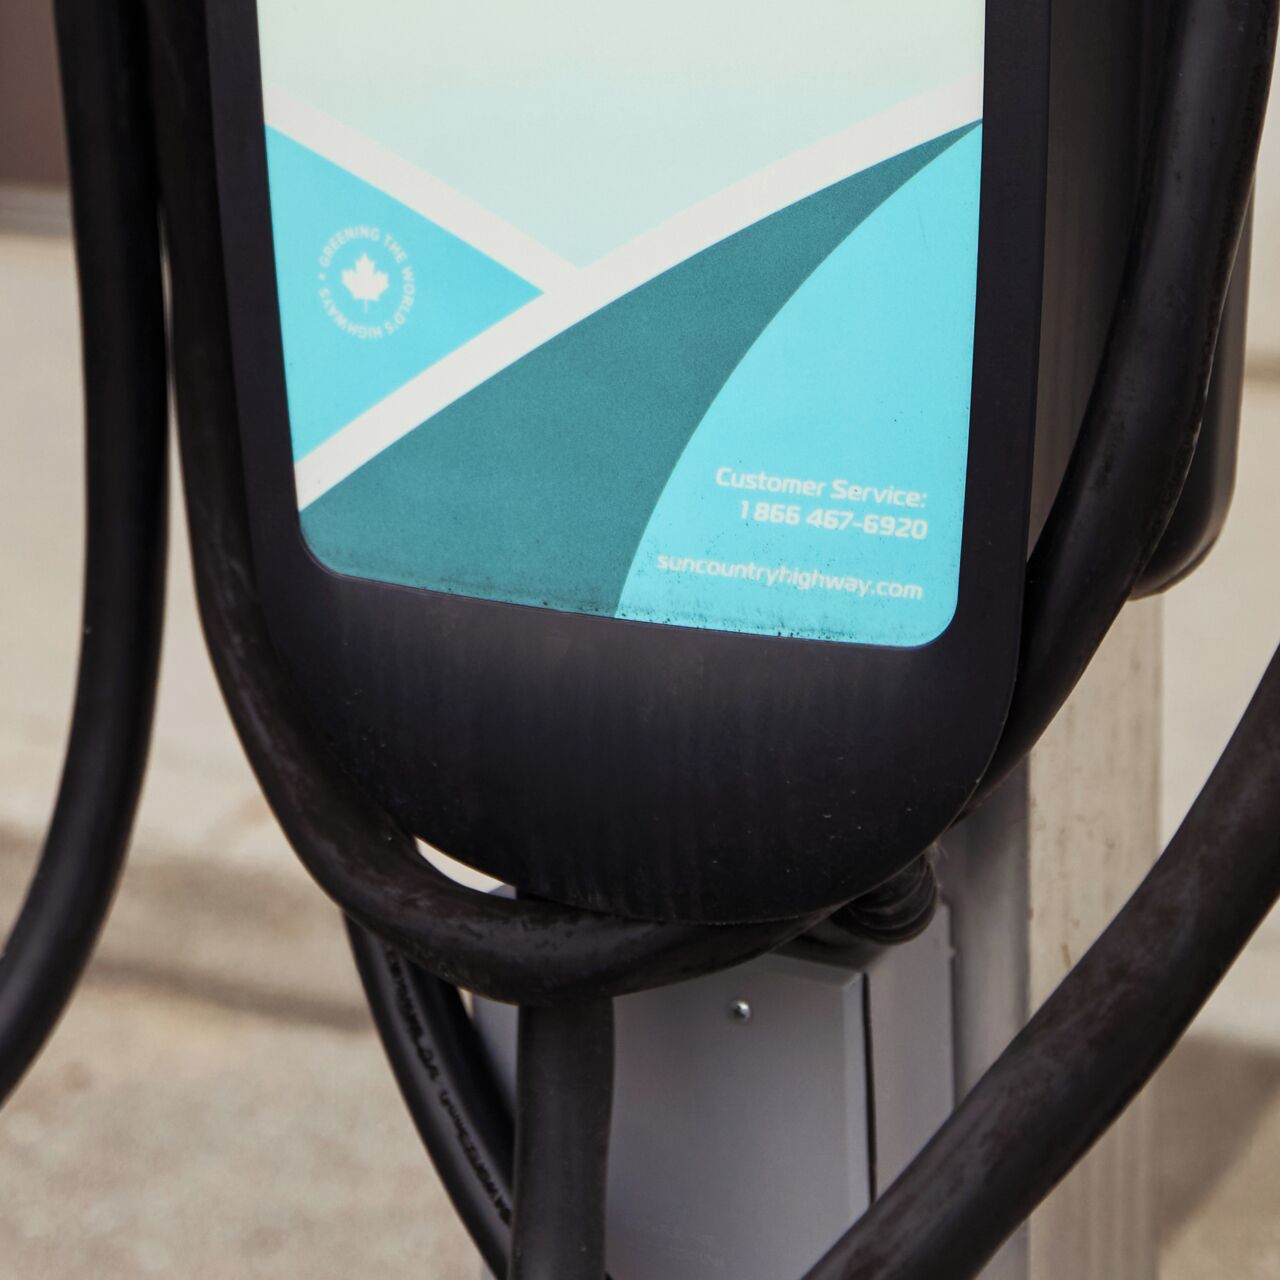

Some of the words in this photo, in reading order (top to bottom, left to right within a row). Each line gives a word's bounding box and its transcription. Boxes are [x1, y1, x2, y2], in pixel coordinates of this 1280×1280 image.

[384, 234, 407, 263] THE
[715, 467, 825, 497] Customer
[831, 479, 928, 509] Service:
[740, 500, 750, 519] 1
[754, 502, 800, 525] 866
[805, 508, 928, 540] 467-6920
[657, 554, 924, 600] suncountryhighway.com
